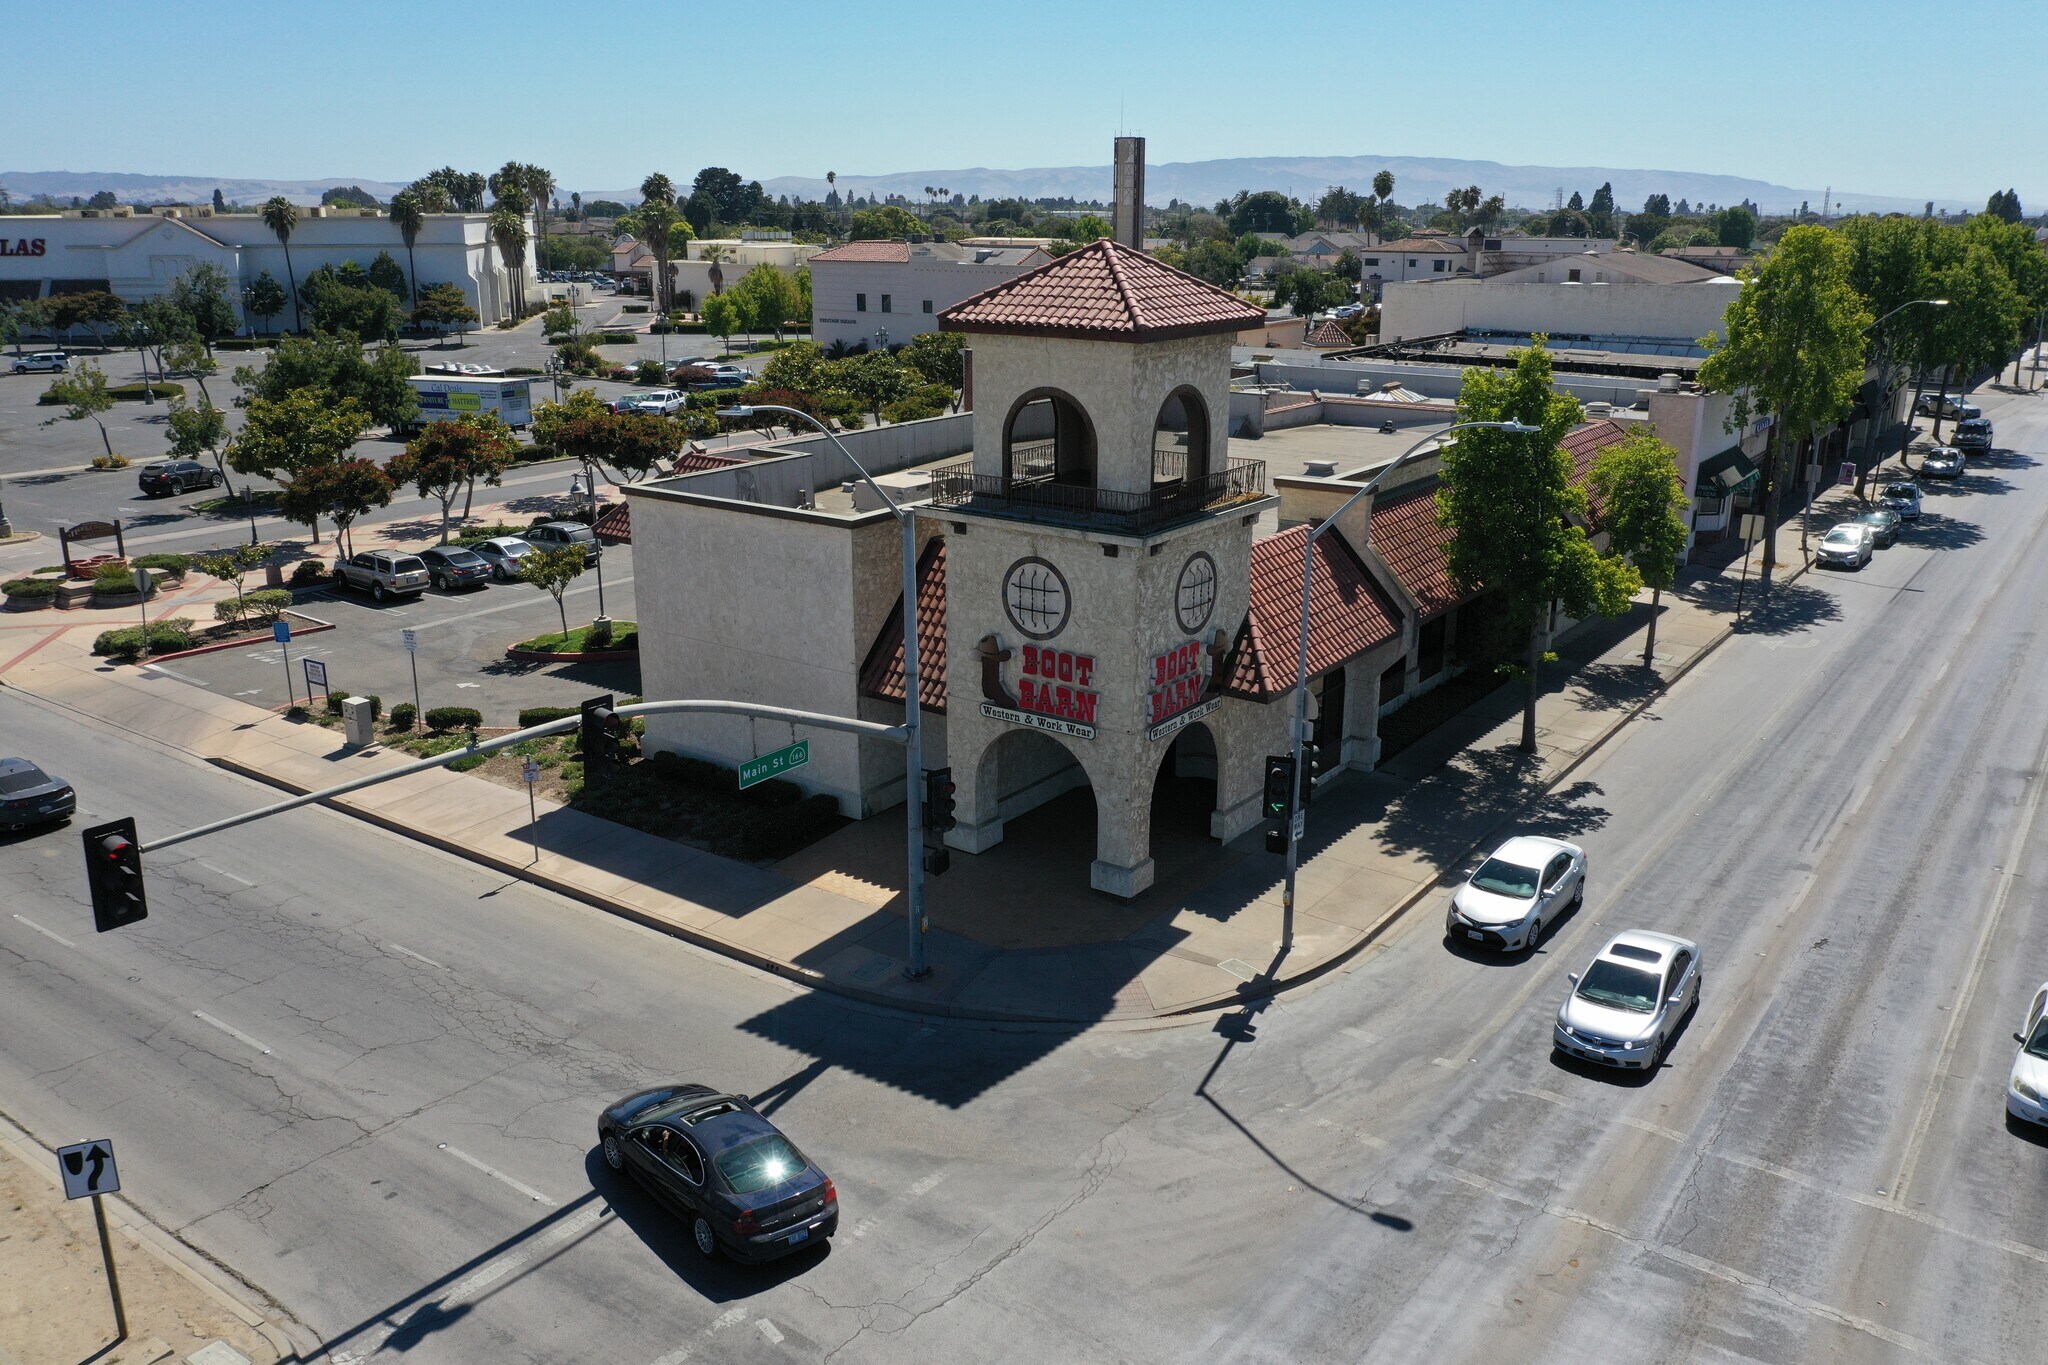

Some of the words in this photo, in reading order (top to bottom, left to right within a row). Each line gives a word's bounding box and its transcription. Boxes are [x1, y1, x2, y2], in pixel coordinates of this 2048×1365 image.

[431, 383, 443, 392] Cal
[444, 383, 463, 393] Deals
[452, 397, 479, 406] MATTRESS
[1022, 644, 1095, 687] BOOT
[1154, 640, 1200, 687] BOOT
[1018, 678, 1099, 723] BARN
[1151, 674, 1201, 723] BARN
[983, 705, 1021, 722] Western
[1024, 714, 1034, 725] &
[1037, 717, 1063, 732] Work
[1066, 723, 1092, 738] Wear
[1152, 720, 1178, 739] Western
[1179, 715, 1186, 725] &
[1188, 706, 1204, 721] Work
[1205, 699, 1221, 713] Wear
[743, 764, 768, 780] Main
[772, 756, 784, 768] St
[792, 752, 804, 761] 166
[1294, 812, 1304, 823] ONE
[1294, 820, 1304, 830] WAY
